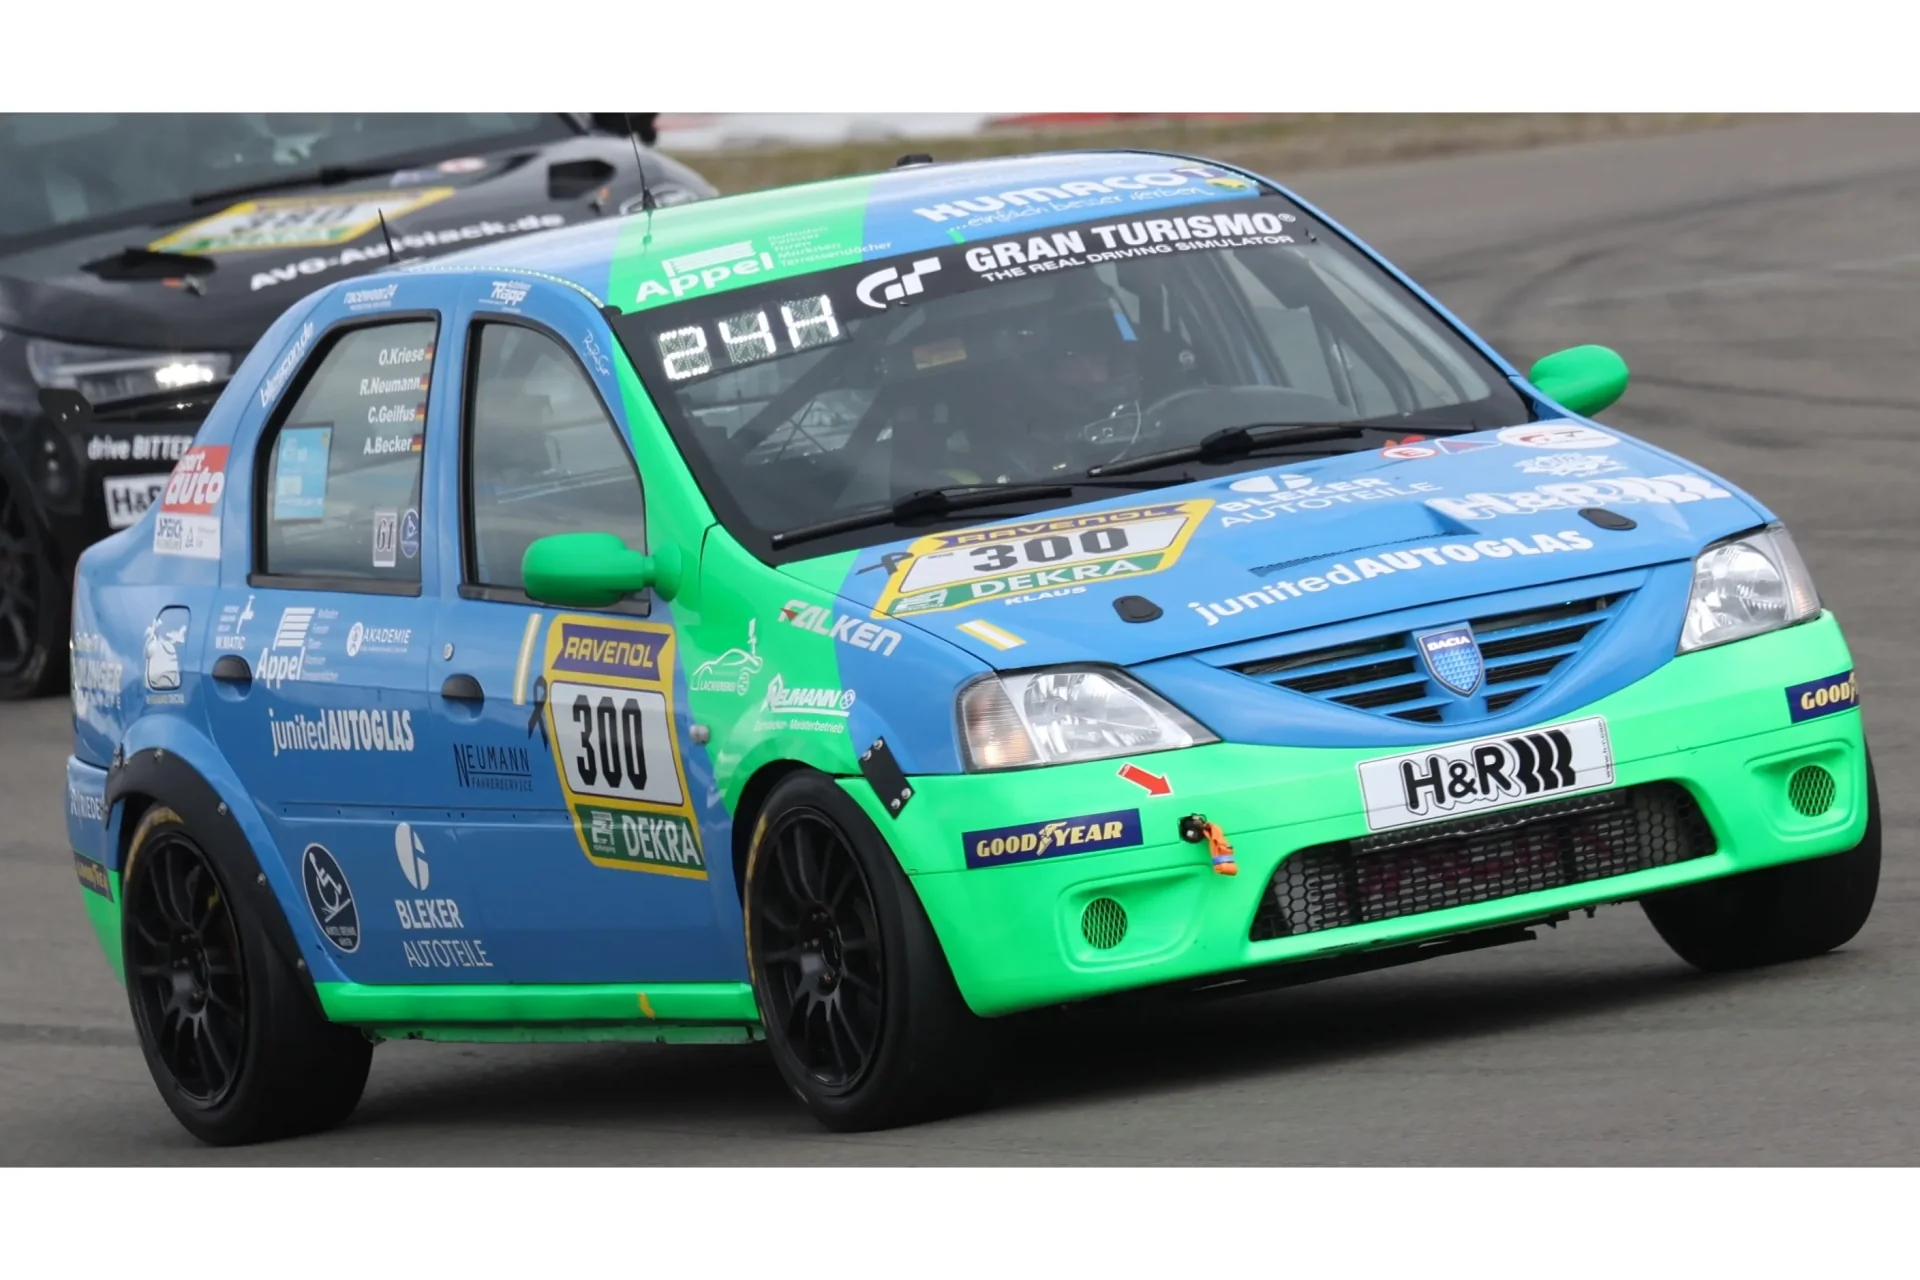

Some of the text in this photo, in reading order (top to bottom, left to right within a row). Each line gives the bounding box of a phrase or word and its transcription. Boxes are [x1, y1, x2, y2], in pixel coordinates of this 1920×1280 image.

[912, 166, 1216, 223] HUMACOT
[965, 229, 1088, 273] GRAN
[981, 234, 1295, 283] THE REAL DRIVING SIMULATOR
[635, 252, 775, 303] Appel
[378, 348, 425, 366] O.Kriese
[359, 376, 421, 396] R.Neumann
[87, 433, 131, 460] drive
[363, 435, 413, 456] A.Becker
[165, 466, 225, 505] auto
[1216, 478, 1390, 513] BLEKER
[1220, 480, 1444, 528] AUTOTEILE
[956, 507, 1169, 544] RAVENOL
[969, 527, 1129, 572] 300
[970, 559, 1144, 598] DEKRA
[1004, 586, 1087, 605] KLAUS
[1188, 530, 1595, 626] junitedAUTOGLAS
[363, 628, 412, 644] AKADEMIE
[777, 599, 902, 657] FALKEN
[1427, 635, 1471, 652] DACIA
[255, 646, 305, 689] Appel
[563, 636, 654, 668] RAVENOL
[268, 707, 415, 758] junitedAUTOGLAS
[572, 694, 648, 790] 300
[453, 742, 531, 788] NEUMANN
[621, 814, 702, 866] DEKRA
[394, 898, 464, 930] BLEKER
[403, 940, 494, 968] AUTOTEILE
